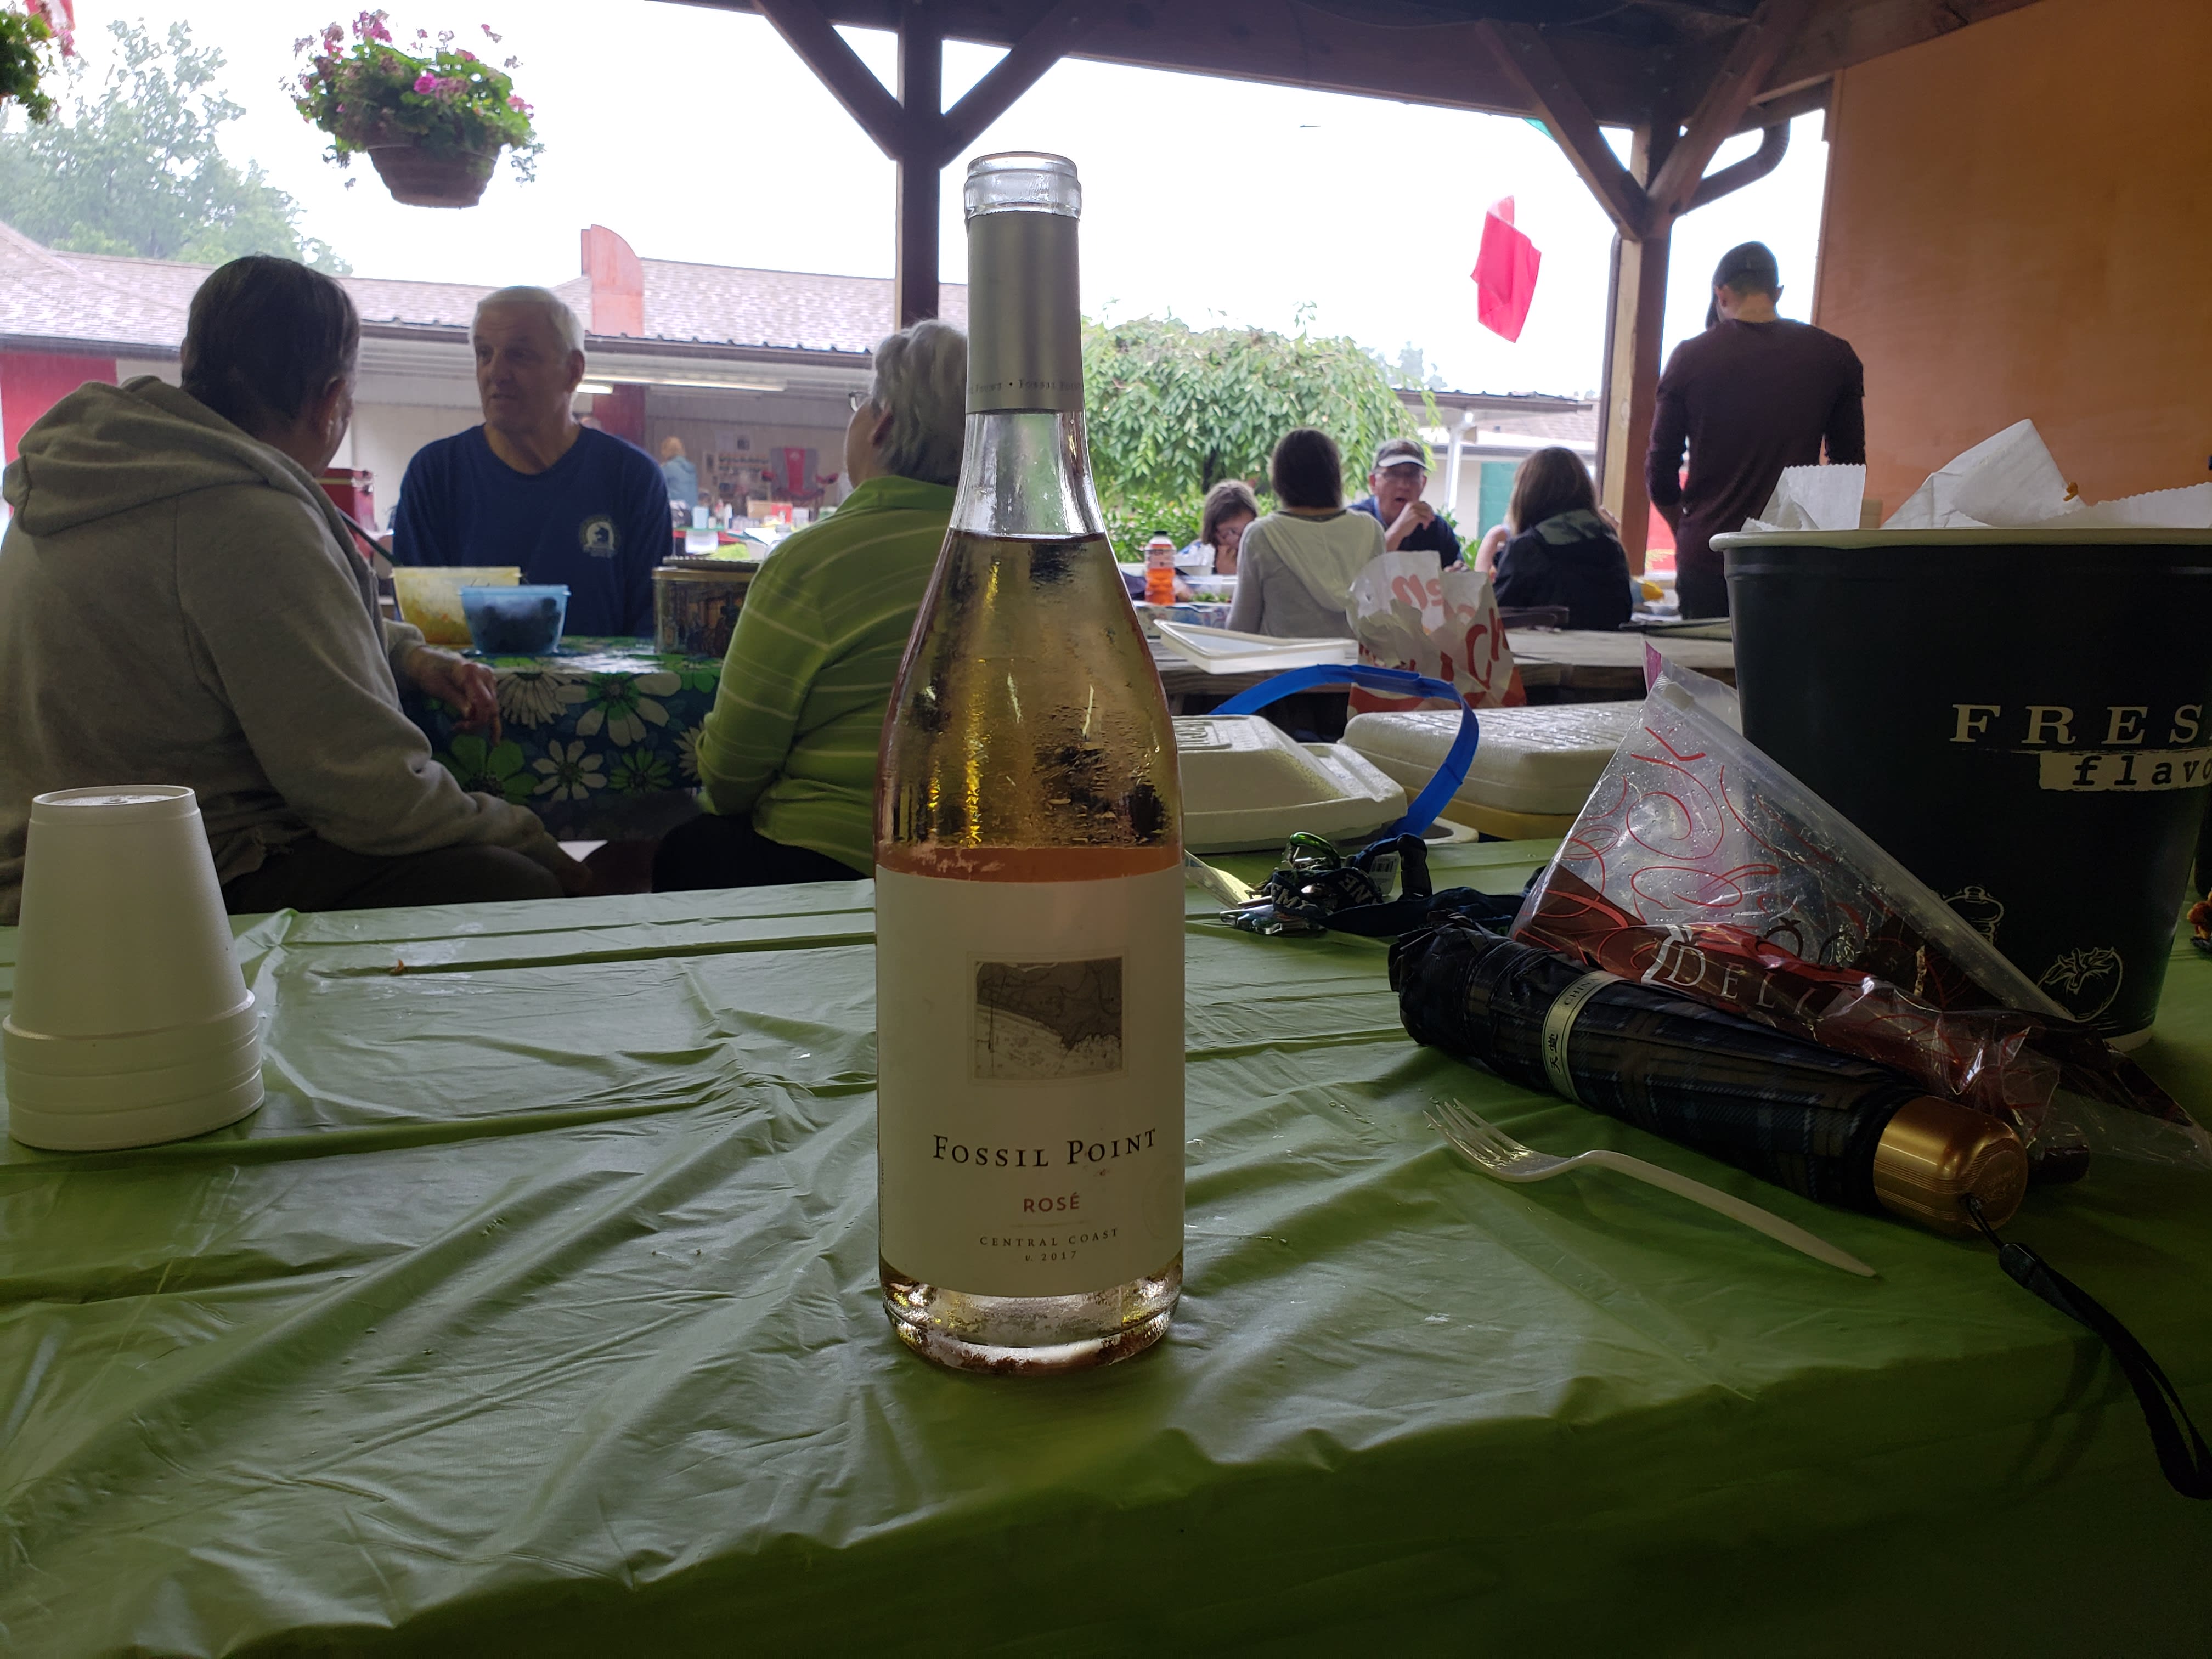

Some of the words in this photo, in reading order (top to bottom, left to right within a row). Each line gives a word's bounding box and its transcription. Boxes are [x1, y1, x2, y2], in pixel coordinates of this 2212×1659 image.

[1949, 704, 2212, 744] FRES
[933, 1135, 1048, 1167] FOSSIL
[1066, 1128, 1156, 1164] POINT
[1024, 1192, 1080, 1212] ROSÉ
[980, 1236, 1058, 1247] CENTRAL
[1069, 1228, 1118, 1244] COAST
[1041, 1251, 1077, 1261] 2017
